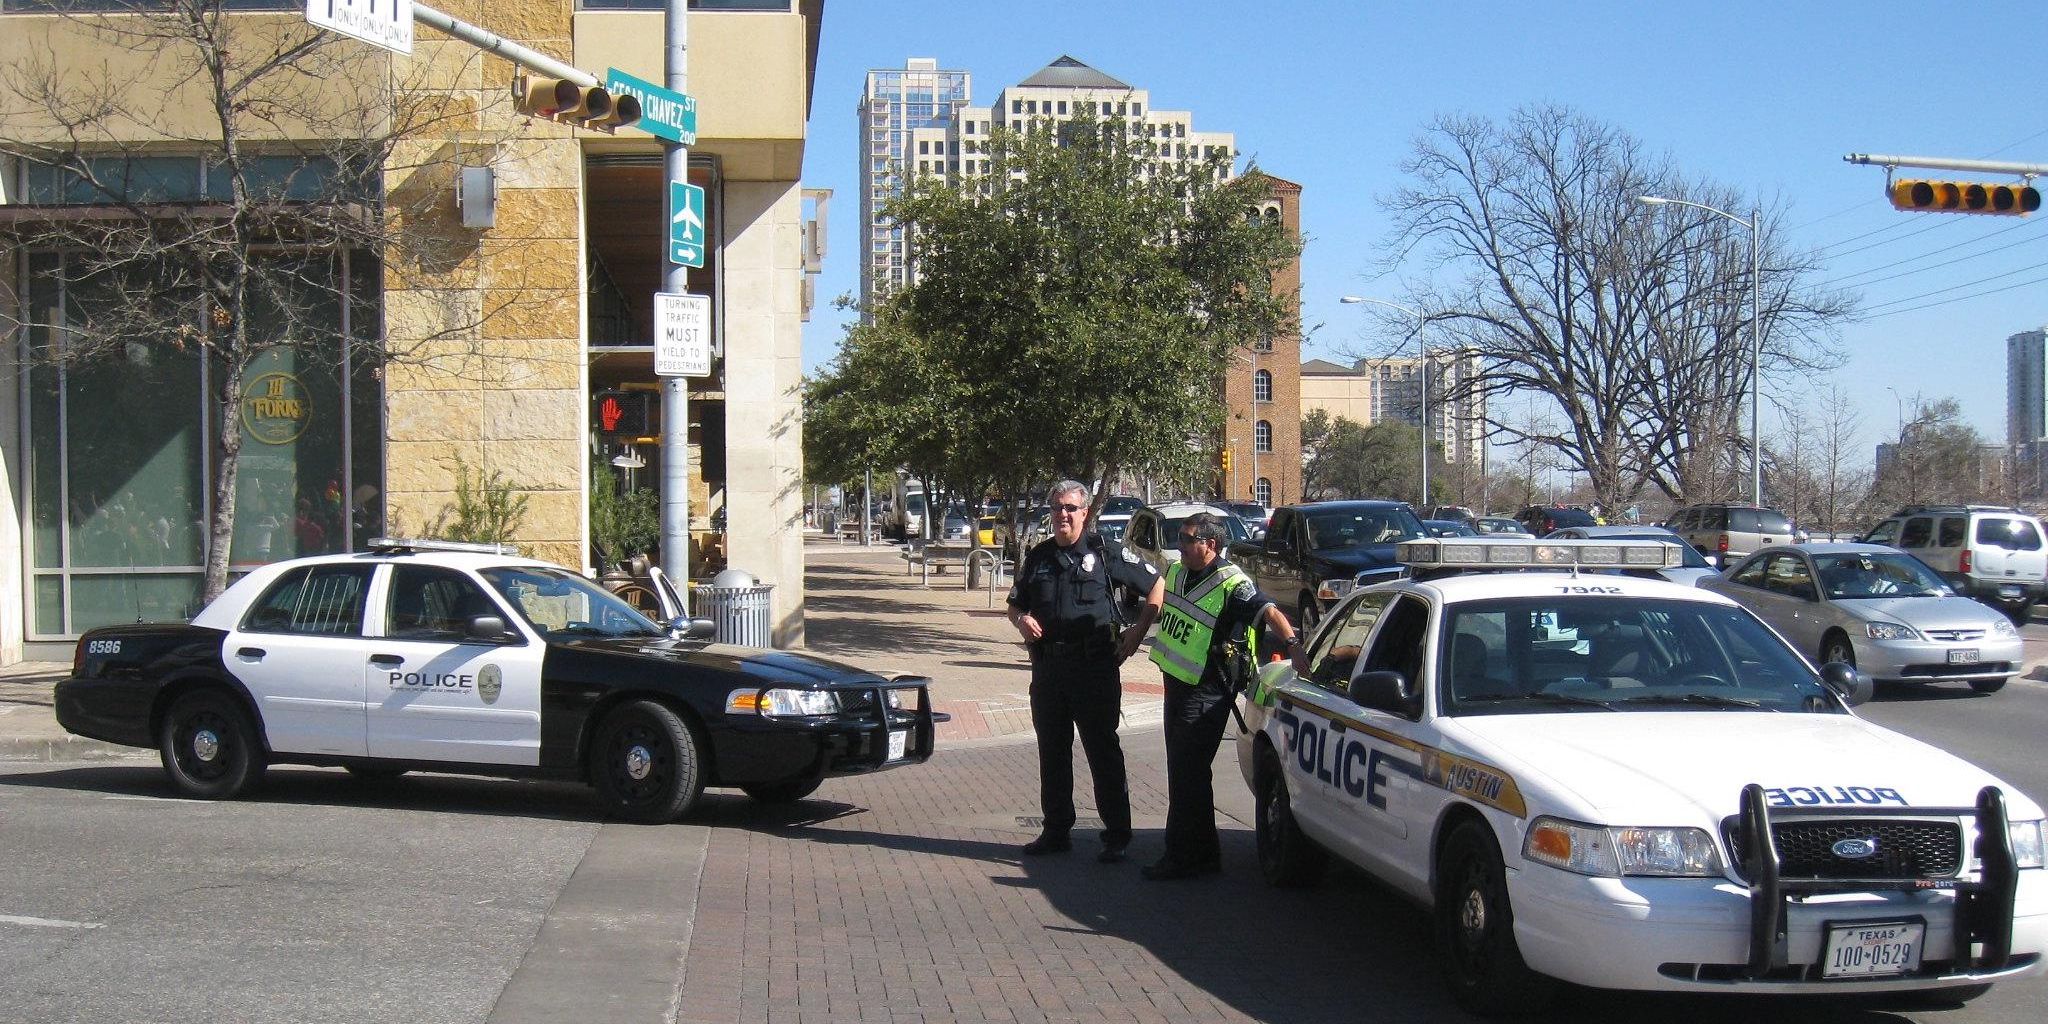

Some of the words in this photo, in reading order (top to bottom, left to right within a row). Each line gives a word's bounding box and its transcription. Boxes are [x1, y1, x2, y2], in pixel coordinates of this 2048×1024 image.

[337, 8, 360, 26] ONLY
[363, 16, 384, 35] ONLY
[388, 25, 408, 44] ONLY
[646, 93, 684, 130] CHAVEZ
[684, 96, 696, 113] ST
[679, 129, 696, 146] 200
[665, 298, 700, 310] TURNING
[666, 312, 700, 324] TRAFFIC
[666, 327, 699, 342] MUST
[662, 347, 686, 358] YIELD
[690, 347, 700, 358] TO
[658, 360, 707, 371] PEDESTRIANS
[250, 398, 304, 420] FORKS
[1554, 586, 1624, 594] 7942
[1160, 609, 1194, 645] OLICE
[89, 640, 121, 654] 8586
[389, 671, 473, 688] POLICE
[1279, 708, 1387, 812] POLICE
[1446, 766, 1504, 801] AUSTIN
[1841, 843, 1866, 855] Ford
[1859, 930, 1895, 941] TEXAS
